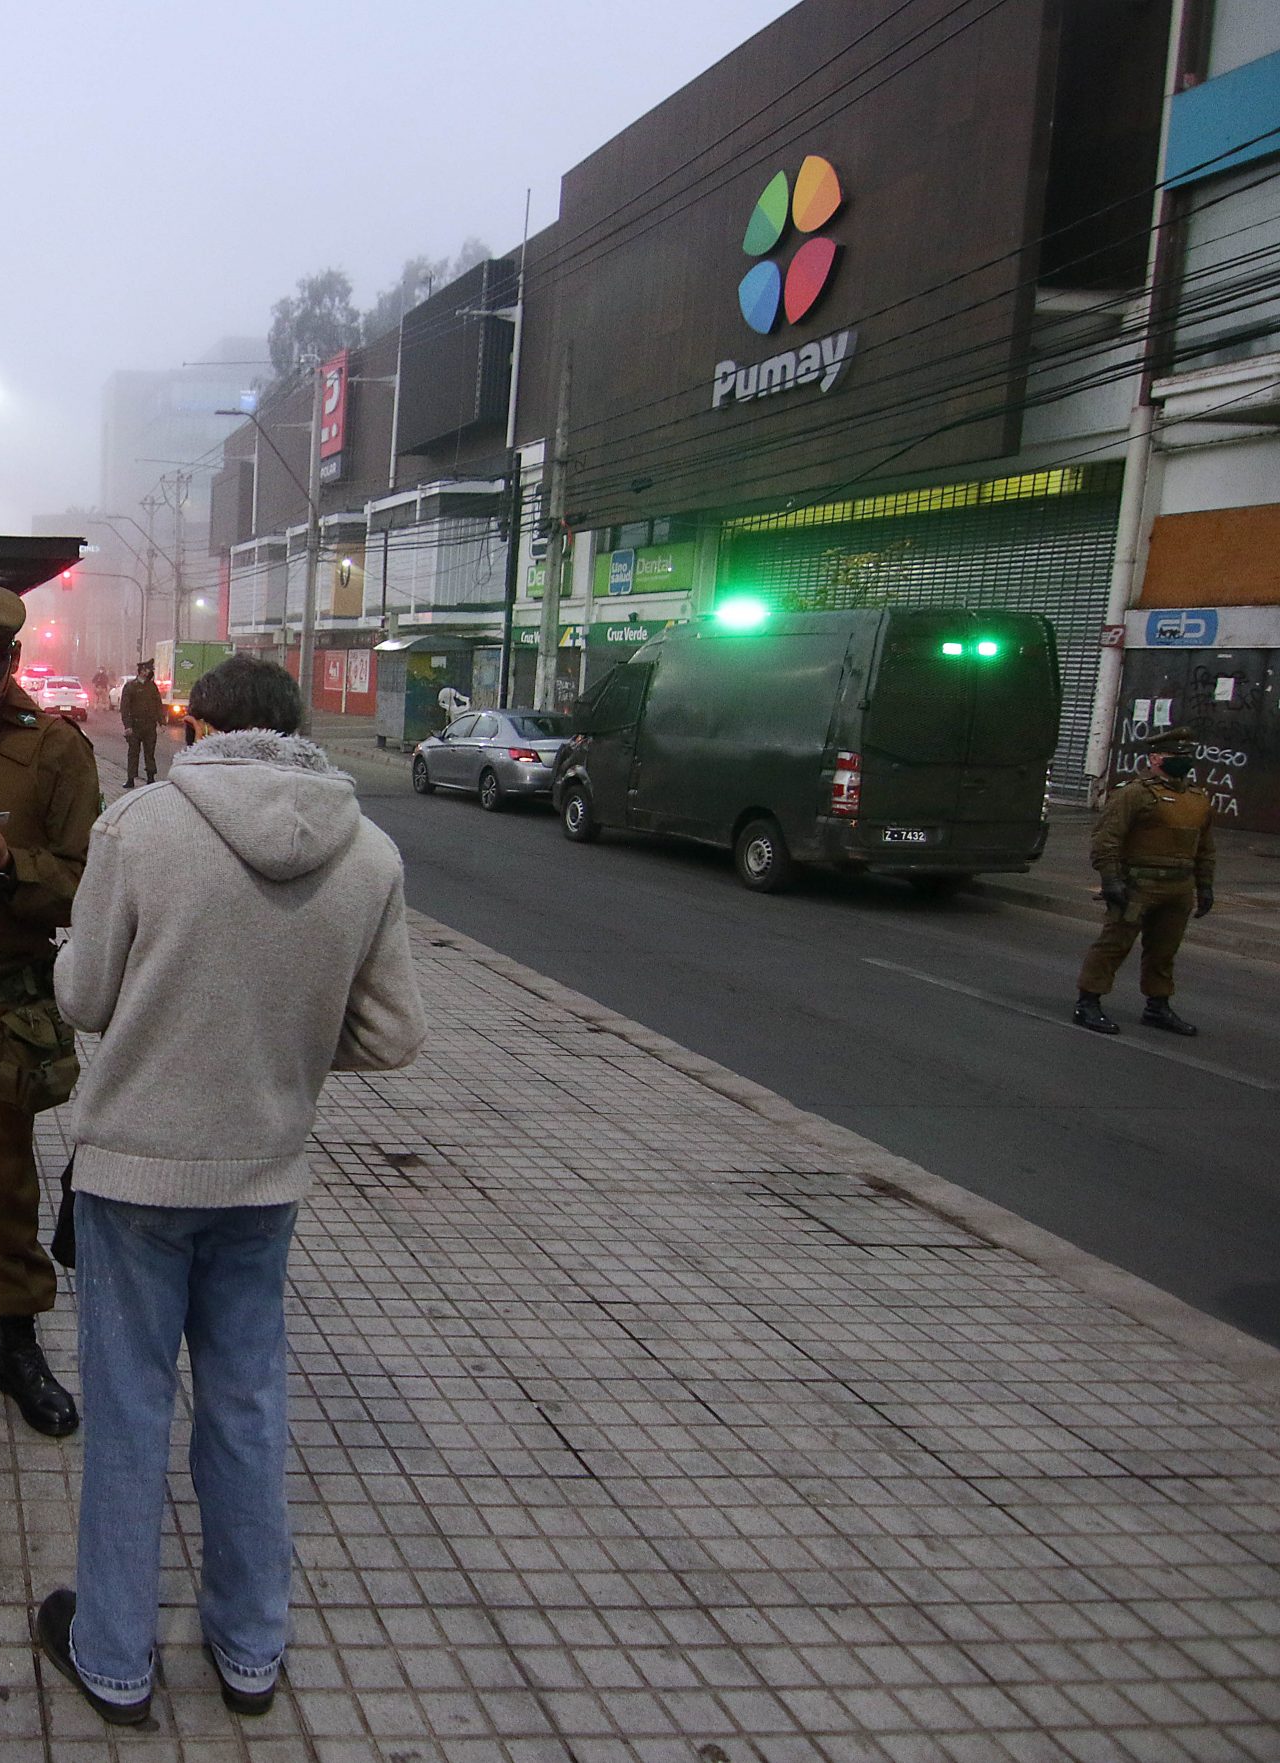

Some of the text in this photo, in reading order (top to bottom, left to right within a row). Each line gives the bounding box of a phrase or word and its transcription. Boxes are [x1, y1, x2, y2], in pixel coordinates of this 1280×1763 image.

[711, 331, 851, 409] Pumay
[637, 554, 672, 575] Dental
[520, 631, 534, 644] Cruz
[607, 626, 648, 641] Cruz Verde
[1122, 718, 1149, 744] NO
[1207, 768, 1234, 789] LA
[901, 831, 925, 841] 7432
